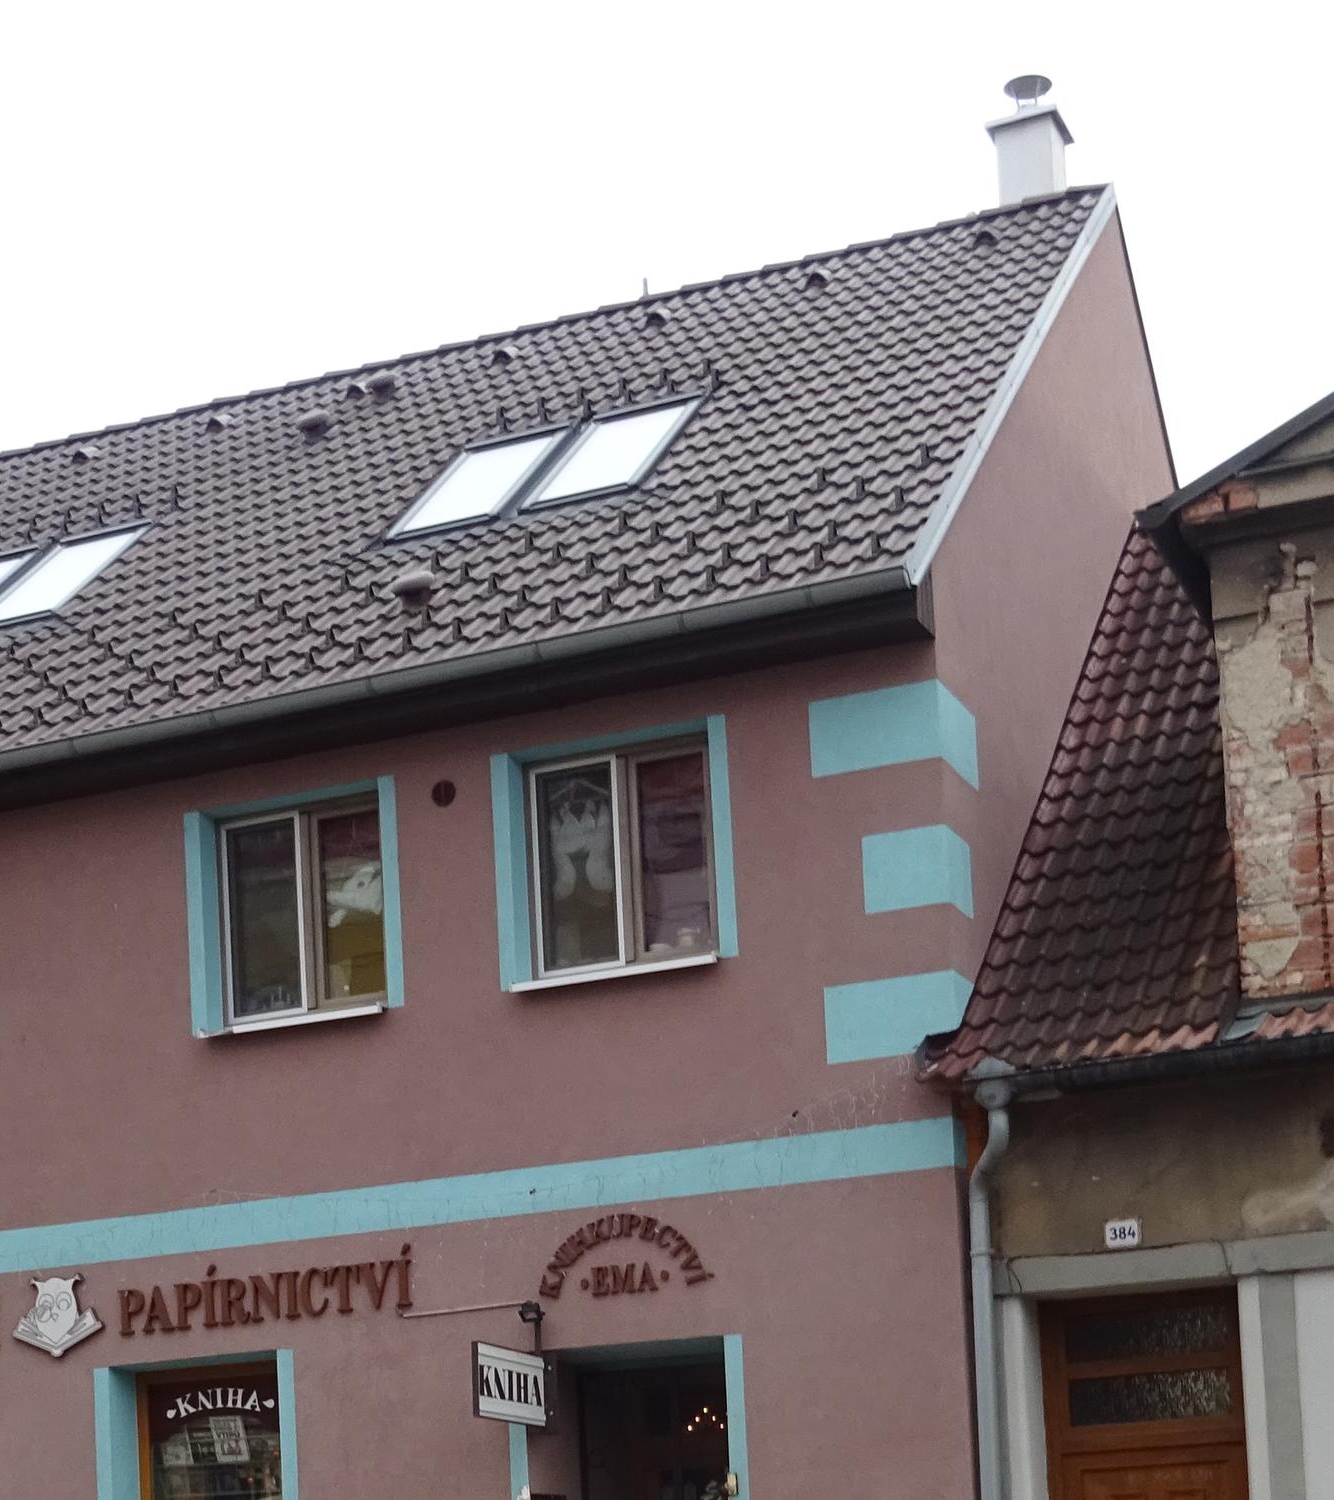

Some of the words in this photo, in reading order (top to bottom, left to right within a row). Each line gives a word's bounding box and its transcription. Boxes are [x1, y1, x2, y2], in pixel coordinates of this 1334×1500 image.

[1109, 1225, 1136, 1241] 384
[539, 1213, 715, 1299] KNIHKUPECTVÍ
[117, 1243, 413, 1336] PAPÍRNICTVÍ
[591, 1261, 659, 1297] EMA
[176, 1387, 261, 1418] KNIHA
[479, 1364, 542, 1407] KNIHA
